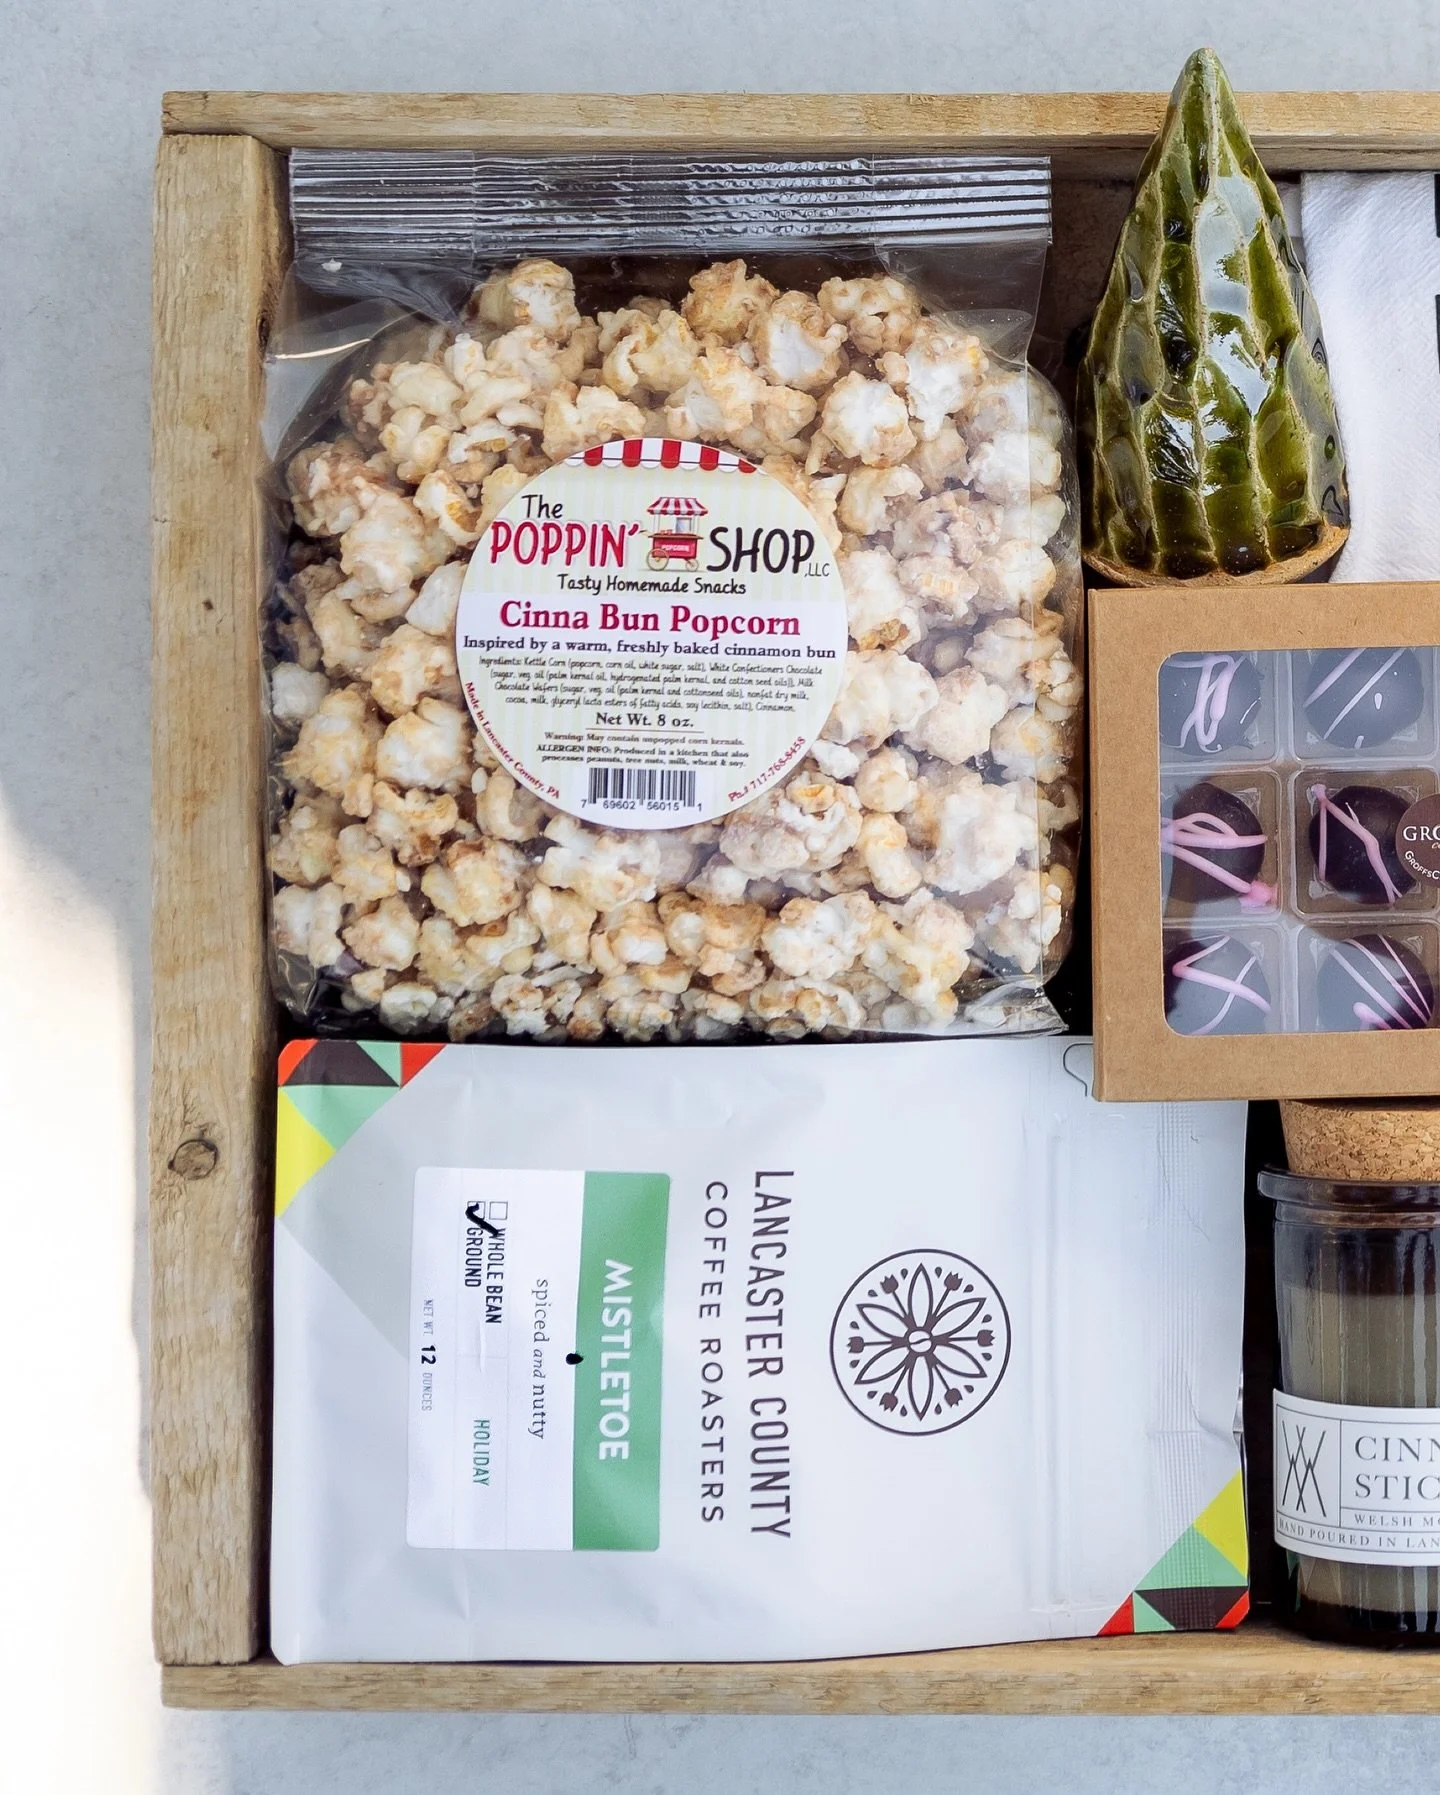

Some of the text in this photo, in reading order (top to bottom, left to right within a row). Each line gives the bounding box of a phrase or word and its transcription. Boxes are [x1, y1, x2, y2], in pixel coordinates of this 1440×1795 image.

[521, 494, 564, 519] The
[488, 520, 641, 568] POPPIN'
[706, 526, 815, 574] SHOP
[557, 573, 747, 596] Tasty Homemade Snacks
[499, 600, 801, 642] Cinna Bun Popcorn
[463, 636, 836, 658] Inspired by a warm, freshly baked cinnamon bun
[524, 657, 546, 666] Kettle
[548, 657, 566, 666] Corn
[605, 661, 622, 669] corn
[639, 660, 659, 669] white
[709, 661, 730, 672] White
[732, 663, 784, 674] Confectioners
[786, 664, 822, 674] Chocolate
[495, 681, 530, 691] Chocolate
[667, 686, 681, 695] and
[775, 690, 789, 702] dry
[610, 672, 660, 684] hydrogenated
[663, 674, 681, 684] palm
[713, 676, 727, 684] and
[755, 677, 772, 686] seed
[604, 698, 627, 707] esters
[629, 697, 637, 709] of
[639, 698, 660, 711] fatty
[686, 702, 699, 712] soy
[595, 712, 694, 728] Net Wt. 8 oz.
[464, 682, 480, 710] Made
[476, 710, 485, 721] in
[482, 720, 515, 763] Lancaster
[546, 786, 560, 799] PA
[536, 744, 585, 753] ALLERGEN
[614, 746, 656, 755] Produced
[676, 748, 708, 757] kitchen
[731, 750, 749, 758] also
[586, 733, 605, 743] May
[692, 758, 717, 766] wheat
[581, 800, 703, 812] 7 69602 56015 1
[465, 1226, 484, 1287] GROUND
[485, 1228, 506, 1324] WHOLE BEAN
[421, 1299, 437, 1412] NET WT 12 OUNCES
[528, 1279, 551, 1440] spiced and nutty
[599, 1259, 634, 1460] MISTLETOE
[699, 1181, 728, 1522] COFFEE ROASTERS
[746, 1171, 794, 1538] LANCASTER COUNTY
[472, 1419, 491, 1486] HOLIDAY
[1355, 1473, 1440, 1500] STIC
[1280, 1518, 1304, 1536] HAND
[1310, 1528, 1370, 1546] POURED
[1379, 1536, 1396, 1547] IN
[1354, 1513, 1440, 1527] WELSH M
